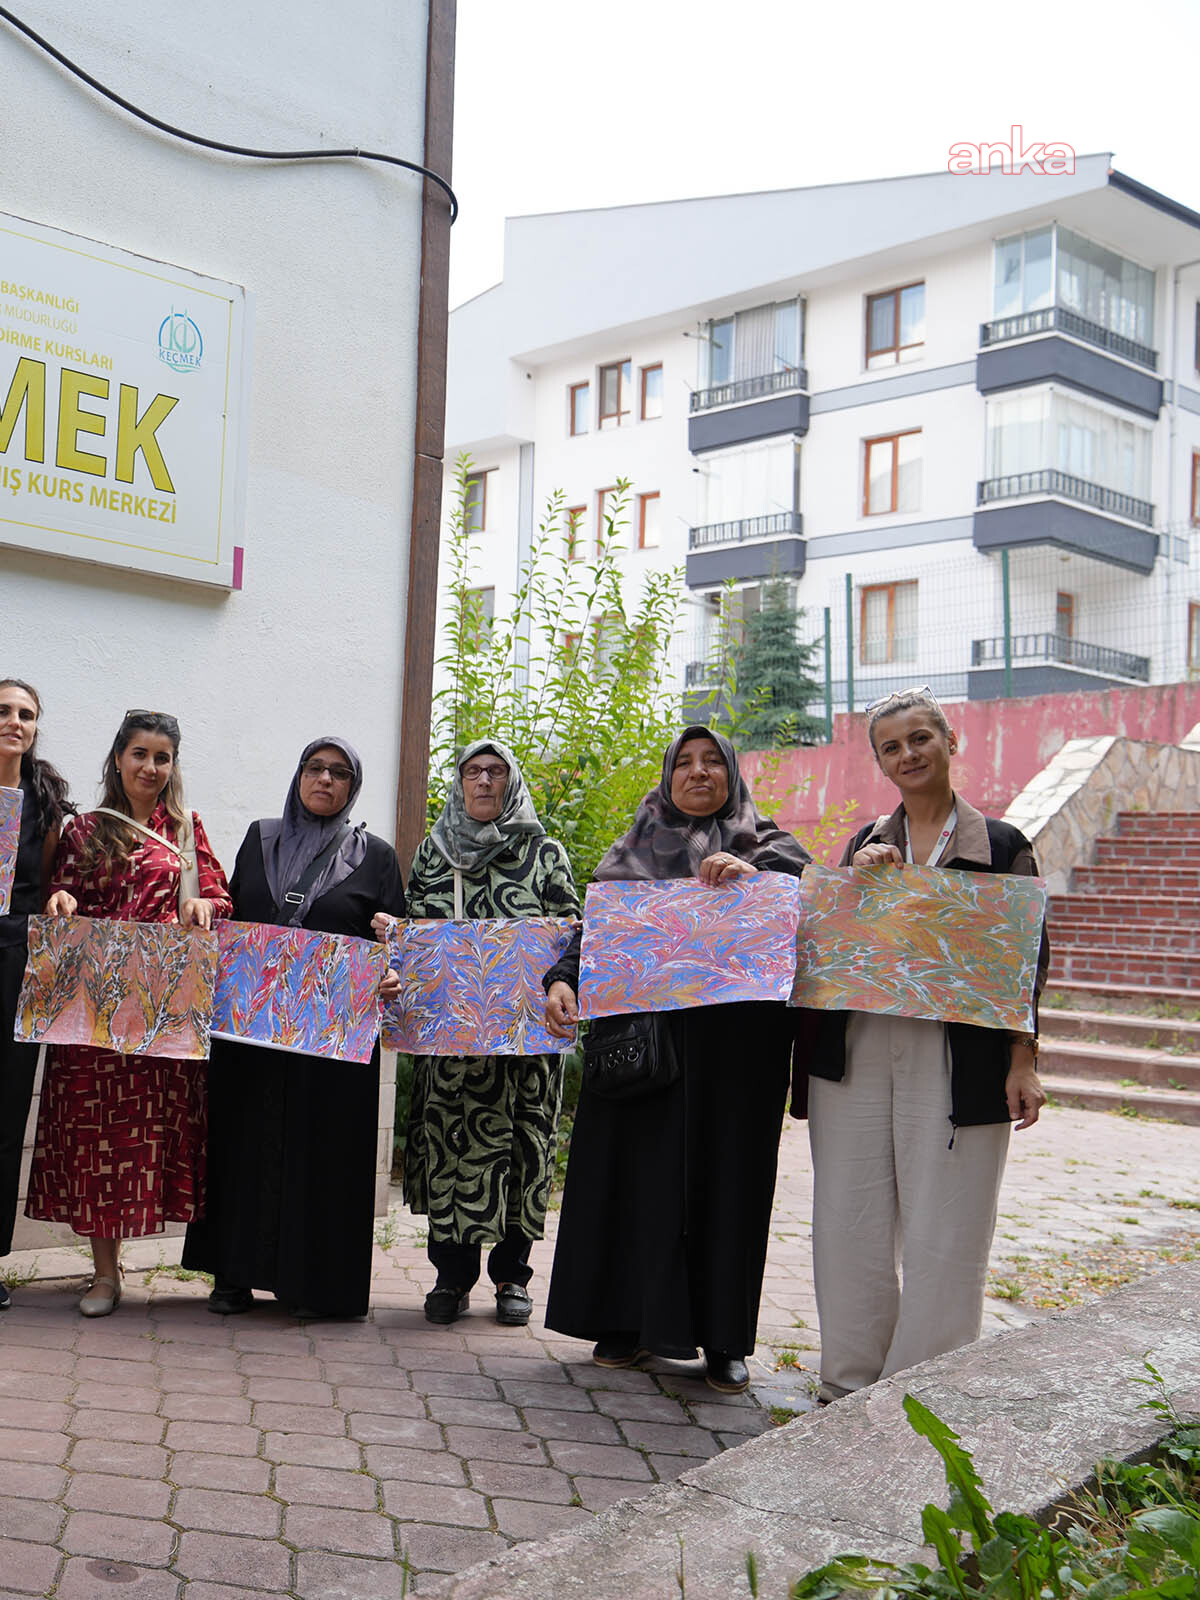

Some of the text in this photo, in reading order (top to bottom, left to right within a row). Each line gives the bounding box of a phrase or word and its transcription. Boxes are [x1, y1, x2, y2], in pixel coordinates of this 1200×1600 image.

[45, 340, 114, 371] KURSLARI
[28, 471, 84, 503] KURS
[89, 486, 177, 524] MERKEZİ
